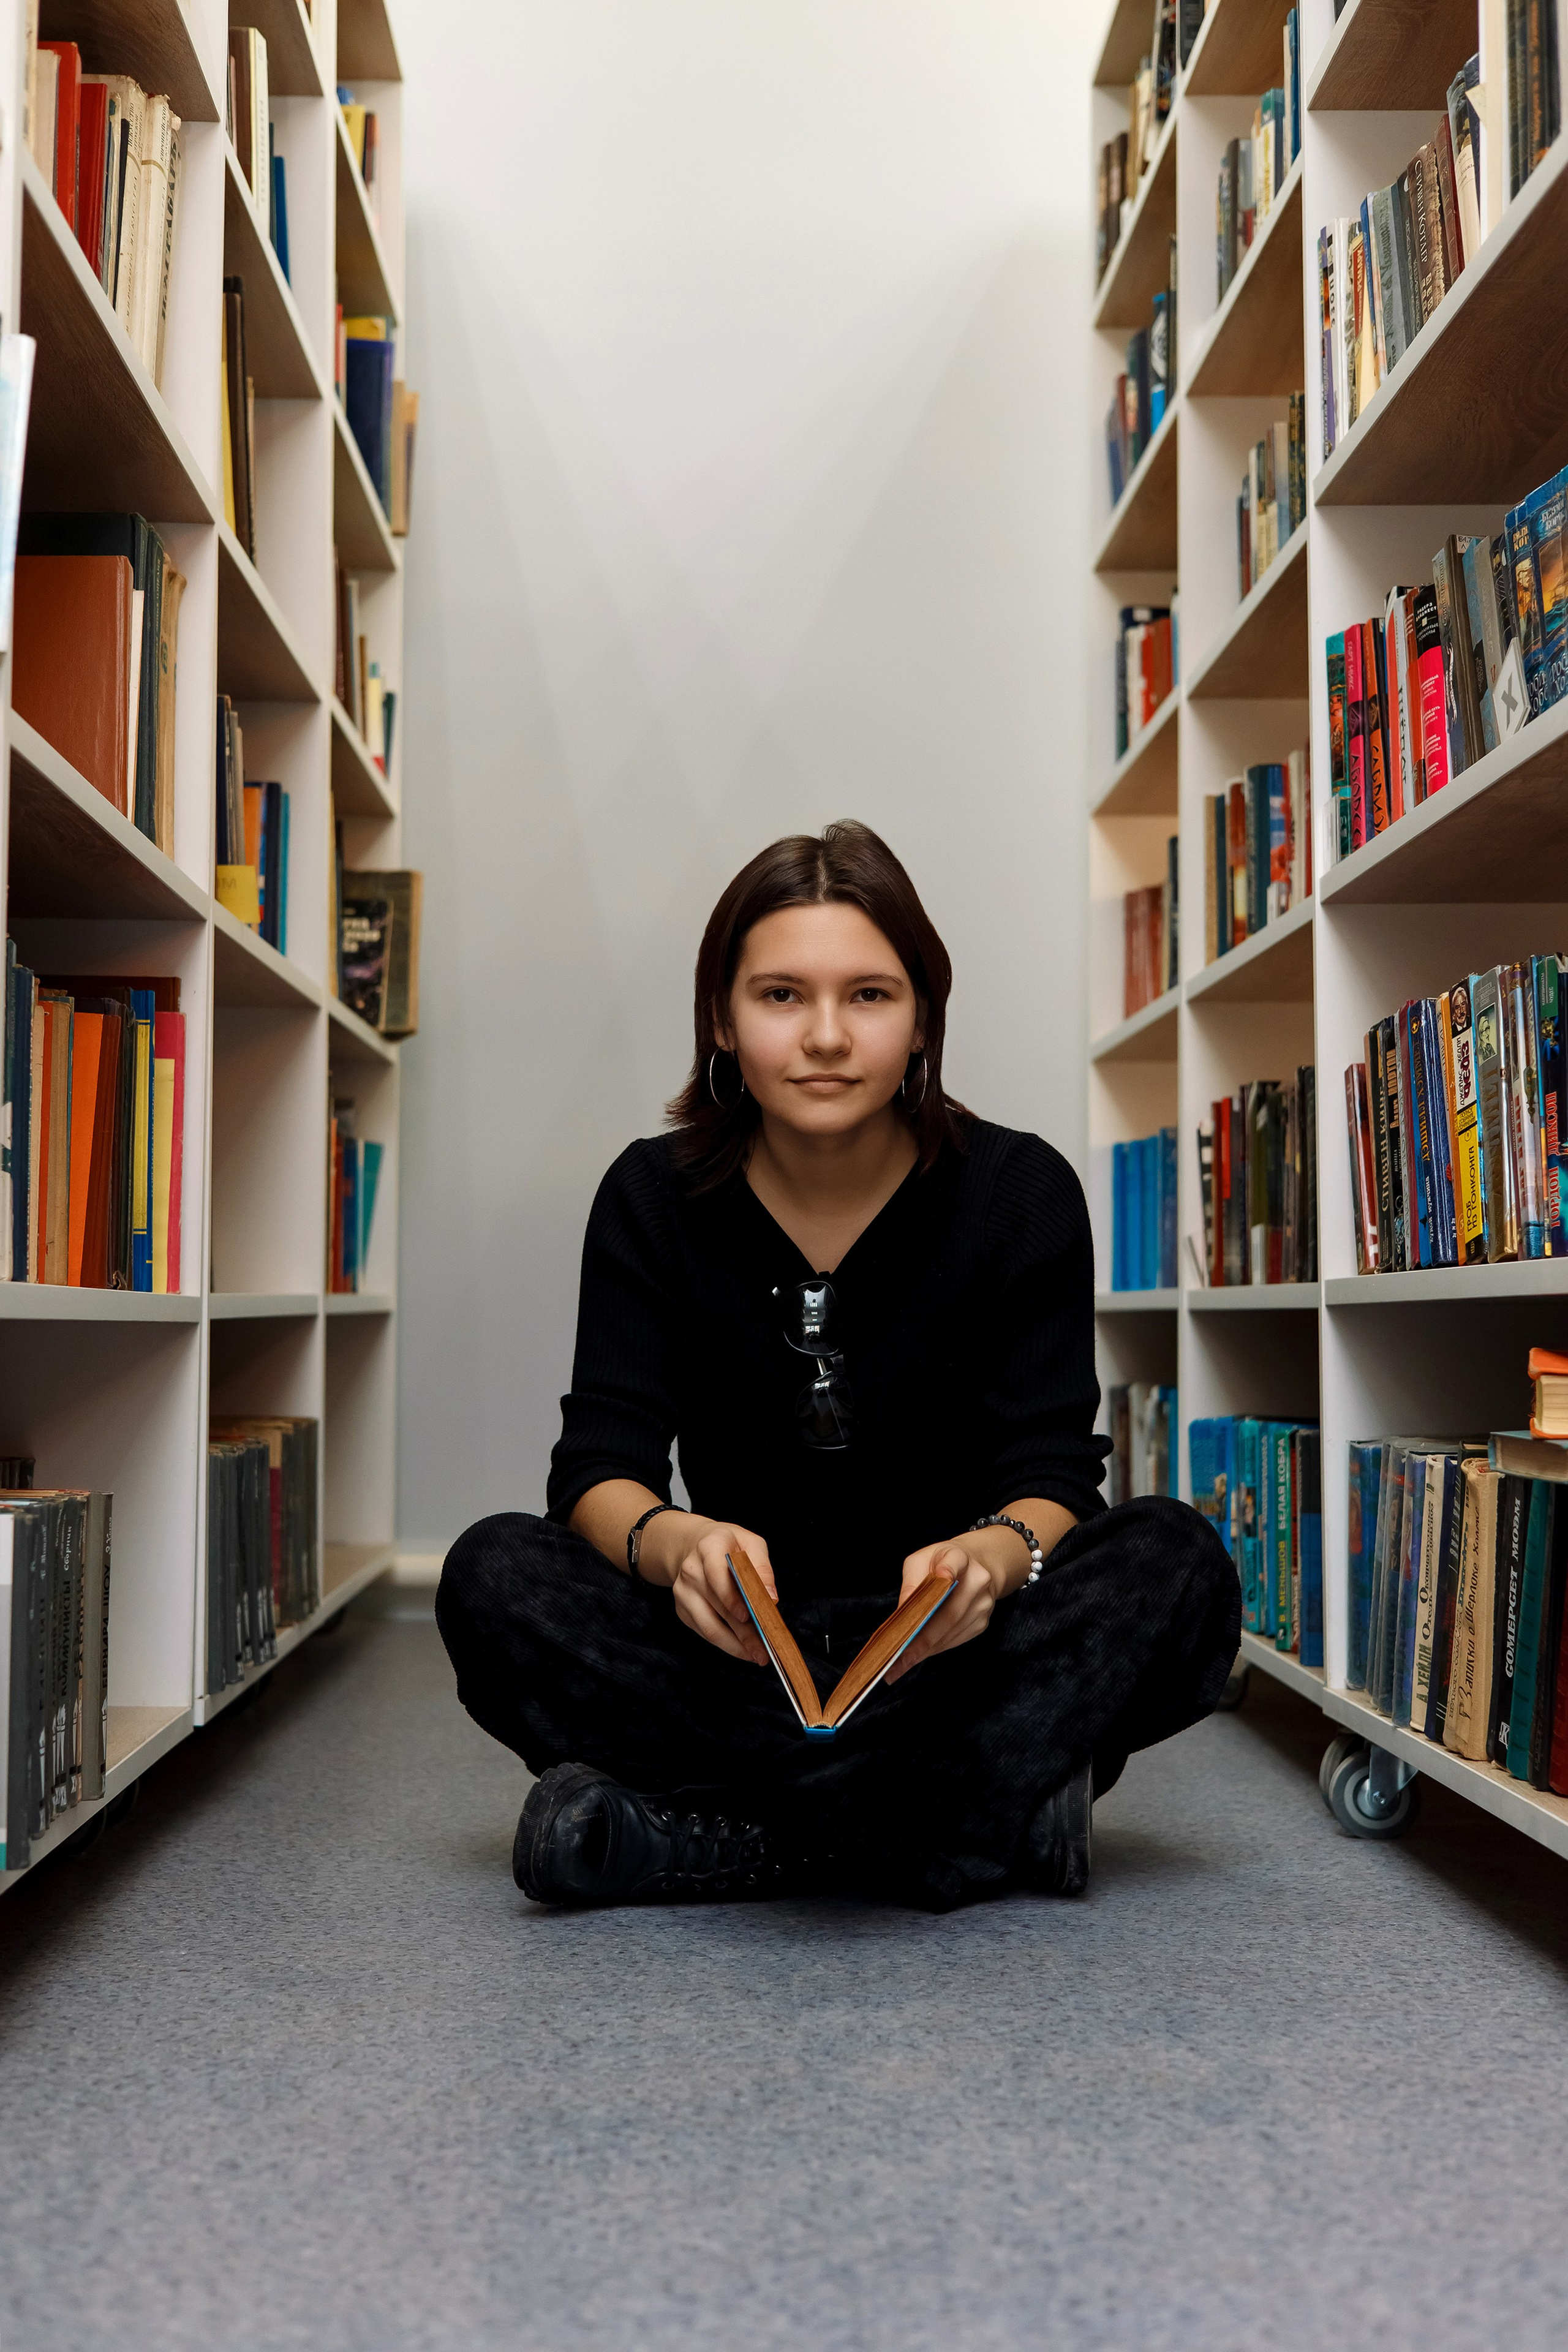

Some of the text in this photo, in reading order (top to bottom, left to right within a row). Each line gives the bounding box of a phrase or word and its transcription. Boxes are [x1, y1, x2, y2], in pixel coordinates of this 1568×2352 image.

[1414, 159, 1424, 212] СТИВЕН
[1418, 212, 1428, 263] КОТЛЕР
[1415, 606, 1438, 622] ДАЙДЖЕСТ
[1417, 602, 1433, 615] РИДЕРЗ
[1528, 671, 1546, 697] оби
[1386, 1047, 1398, 1097] НОРТОН
[1413, 1041, 1431, 1161] ДЭШИЛЛ ХЭММЕТ
[1380, 1140, 1390, 1213] СТИВЕН
[1545, 1091, 1561, 1229] ГОРДОН ДИКСОН
[1471, 1214, 1477, 1229] ИЗ
[1278, 1485, 1286, 1530] БЕЛАЯ
[102, 1565, 111, 1606] ШОУ
[1464, 1562, 1479, 1624] Шерлоке
[1505, 1496, 1521, 1678] СОМЕРСЕТ МОЭМ
[61, 1525, 72, 1697] КОММУНИСТЫ Сборник
[1468, 1626, 1476, 1637] о
[1417, 1643, 1433, 1689] ХЕЙЛИ
[1458, 1639, 1476, 1708] Записки
